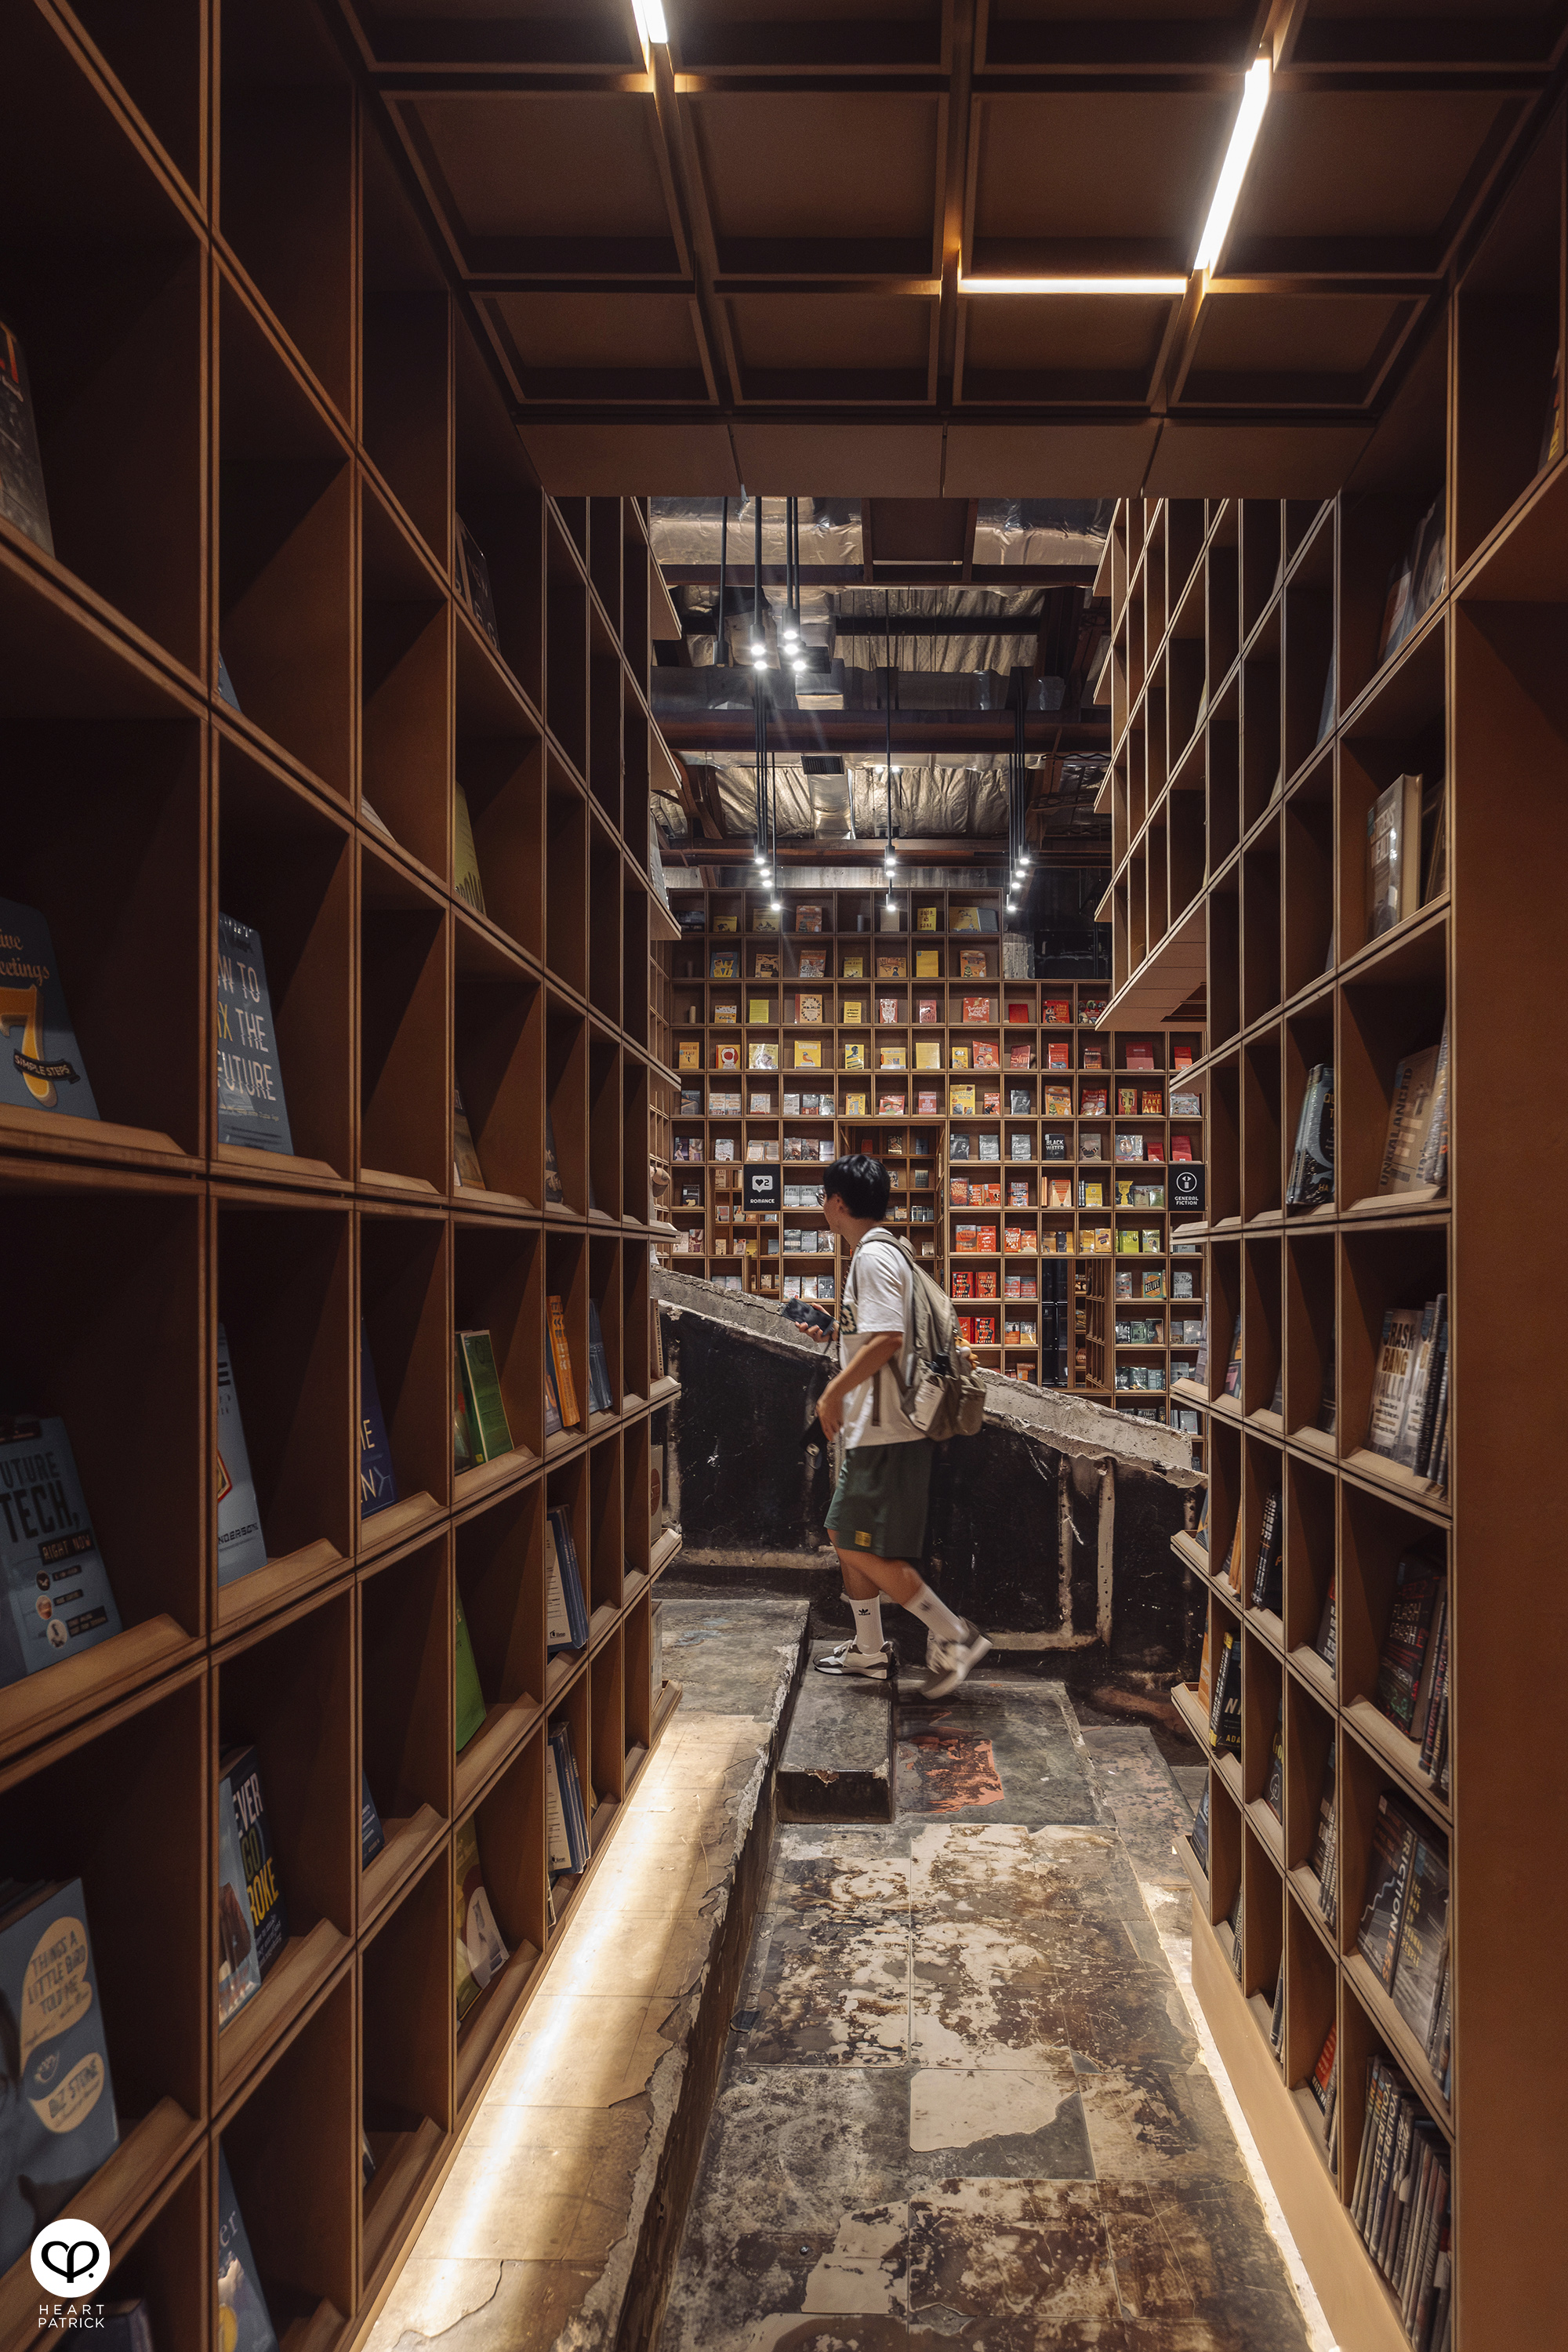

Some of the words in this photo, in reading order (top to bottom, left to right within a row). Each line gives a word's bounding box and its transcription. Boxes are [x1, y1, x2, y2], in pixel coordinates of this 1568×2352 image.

[237, 961, 260, 1004] TO
[235, 1007, 269, 1053] THE
[14, 1054, 45, 1076] SIMPLE
[45, 1064, 71, 1077] STEPS
[1145, 1279, 1160, 1293] RELIVE
[1382, 1347, 1409, 1375] BANG
[0, 1451, 60, 1489] UTURE
[218, 1523, 260, 1544] NDERSON
[1226, 1733, 1241, 1744] ADA
[233, 1772, 263, 1839] EVER
[247, 1857, 280, 1927] ROKE
[1381, 1828, 1413, 1984] FRICTIONLESS
